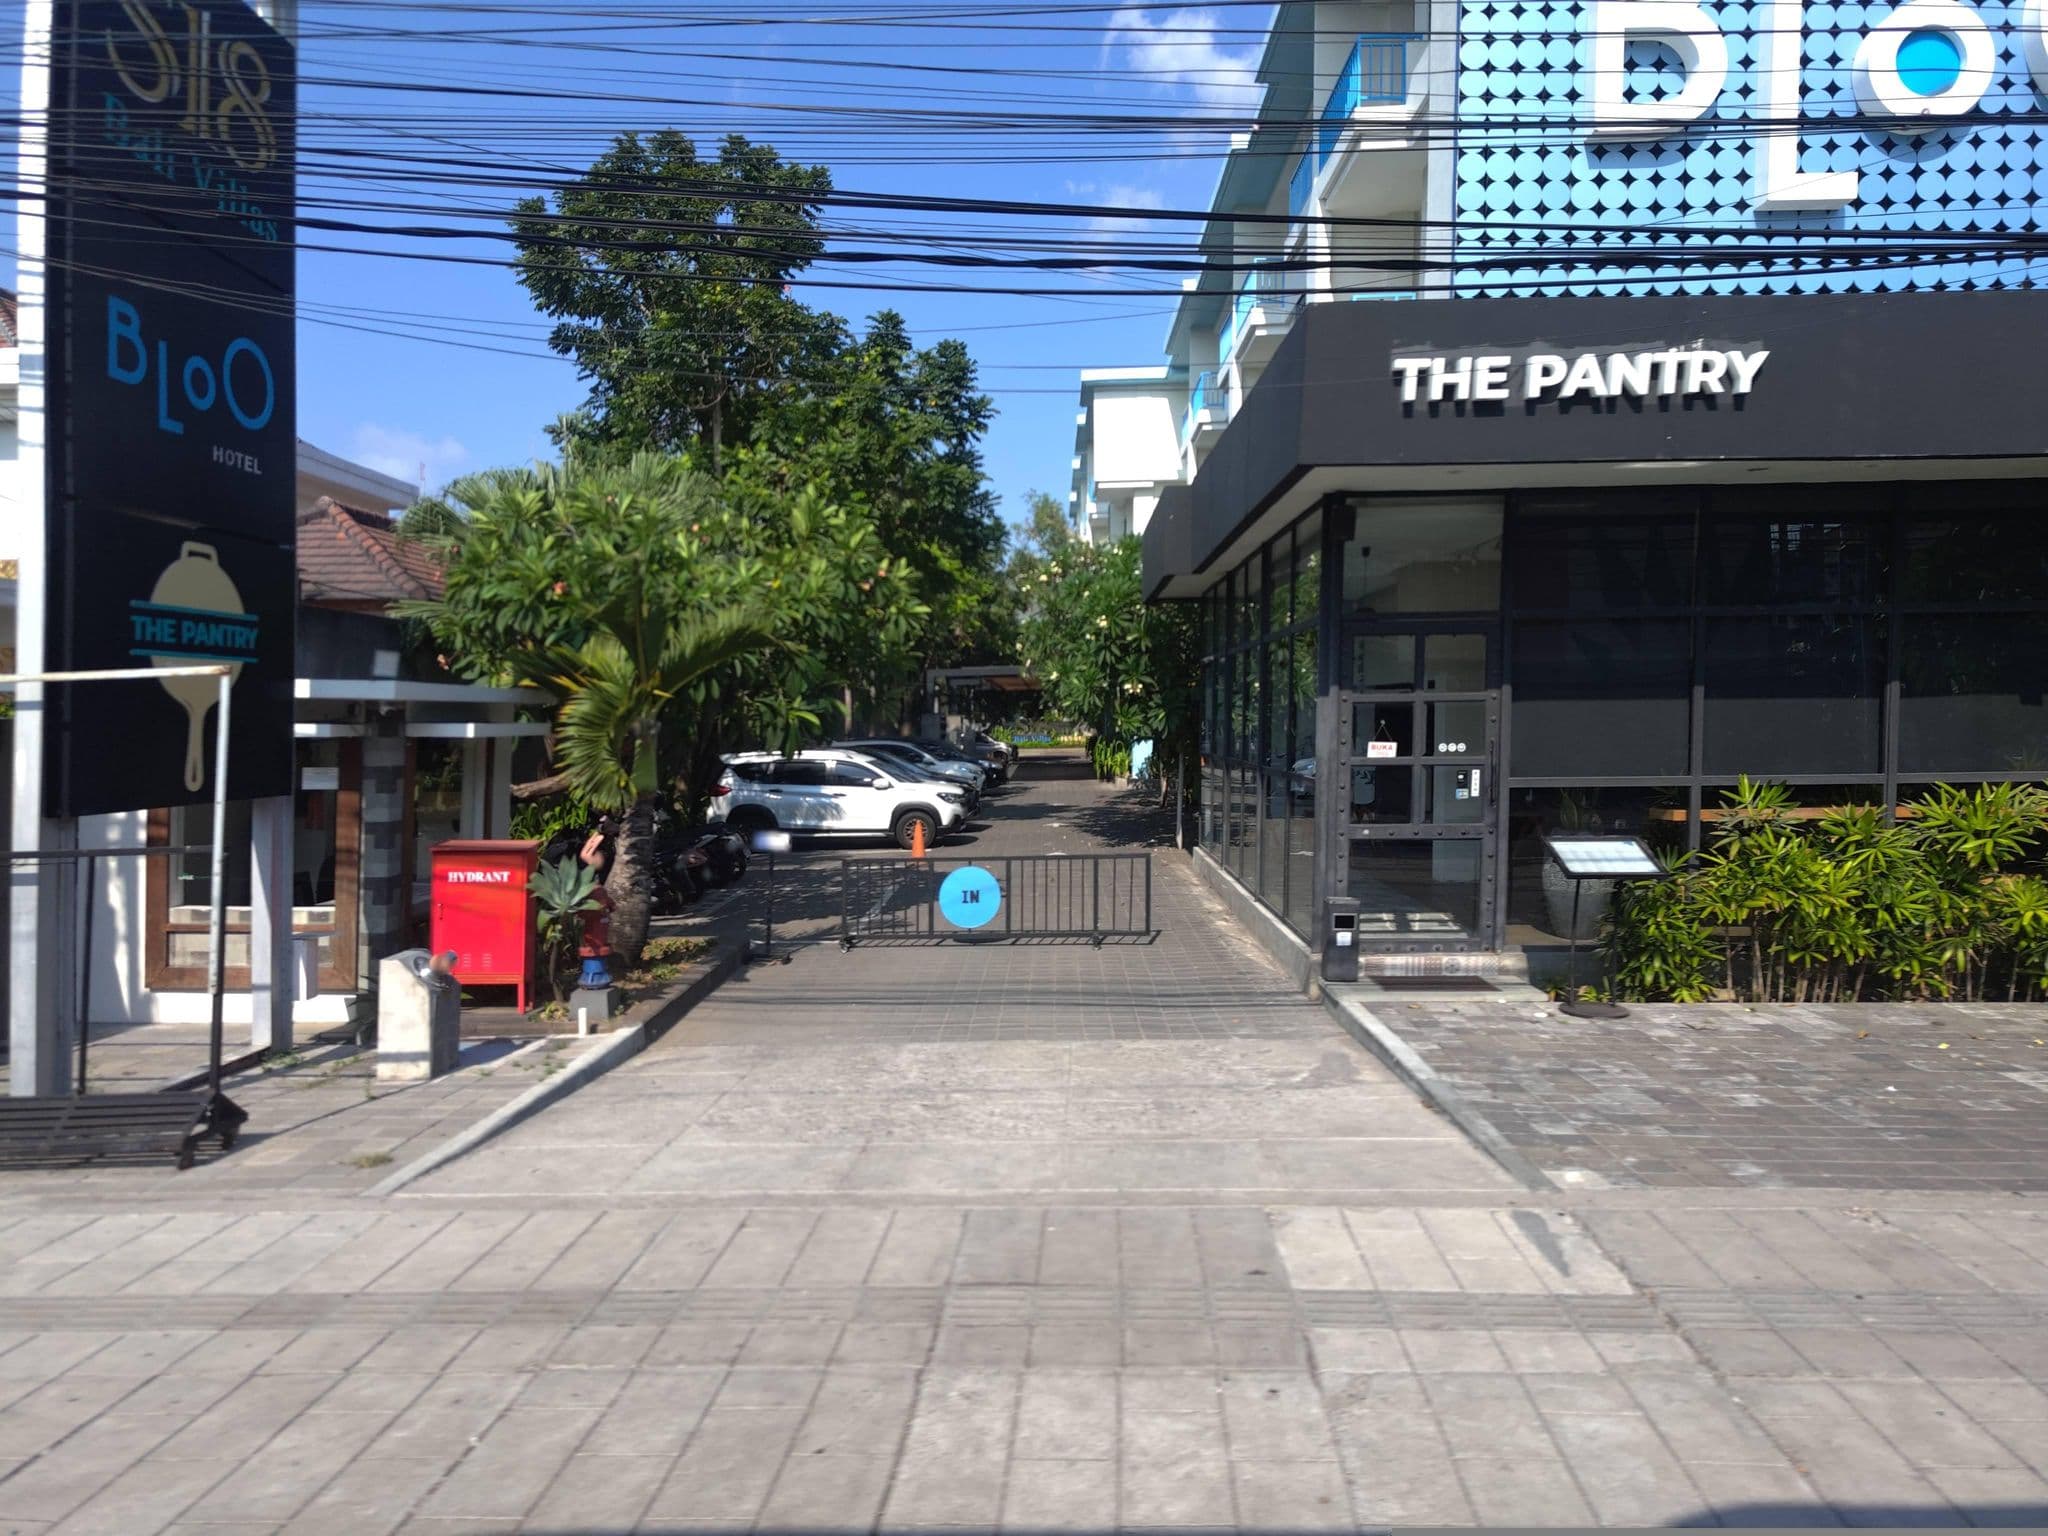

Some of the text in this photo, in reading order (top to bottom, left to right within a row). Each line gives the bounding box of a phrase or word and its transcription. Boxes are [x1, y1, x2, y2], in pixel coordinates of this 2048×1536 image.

[1391, 349, 1770, 401] THE PANTRY
[212, 445, 263, 475] HOTEL
[130, 615, 258, 649] THE PANTRY
[448, 871, 511, 882] HYDRANT
[961, 889, 980, 904] IN
